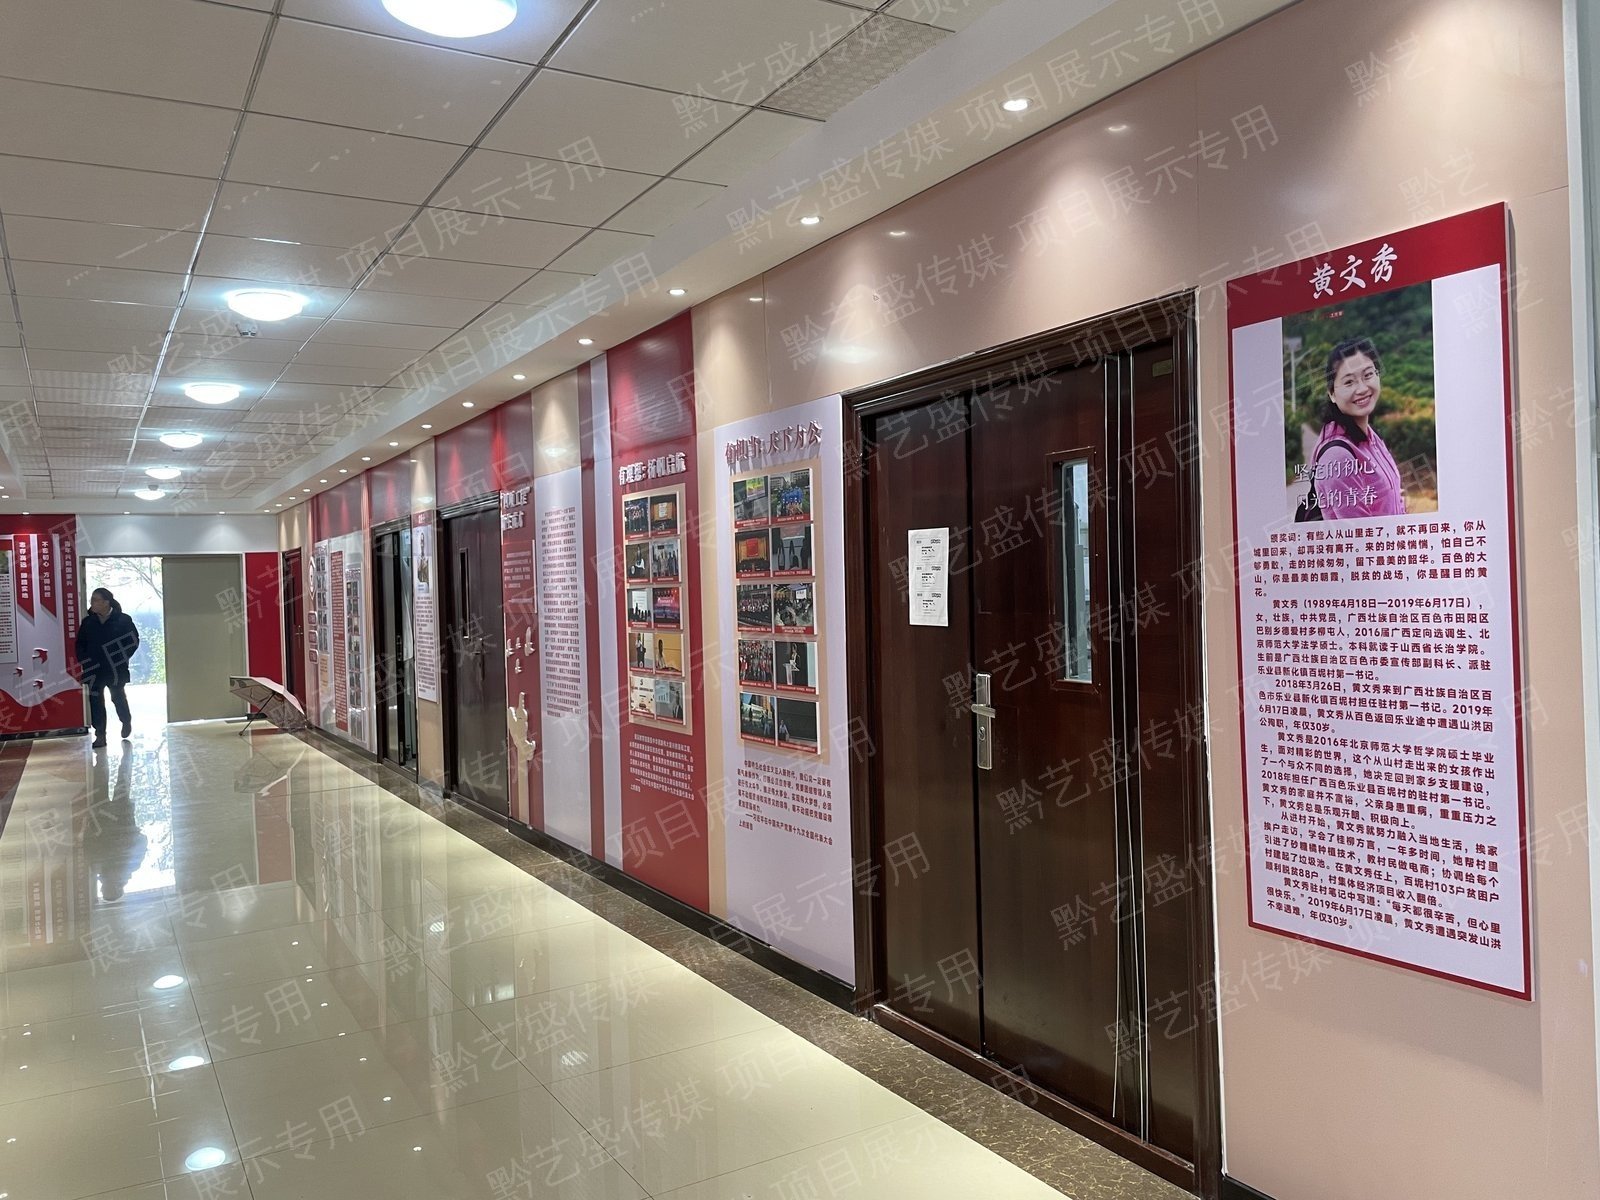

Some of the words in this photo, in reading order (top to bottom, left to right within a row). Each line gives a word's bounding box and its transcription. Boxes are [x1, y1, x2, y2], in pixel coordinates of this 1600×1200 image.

[1309, 243, 1398, 299] 黄文秀
[1294, 458, 1376, 482] 坚定的初心
[1297, 486, 1378, 511] 闪光的青春
[1255, 588, 1266, 597] 花。
[1256, 613, 1489, 624] 女，壮族，中共党员，广西壮族自治区百色市田阳区
[1258, 666, 1379, 681] 乐业县新化镇百坭村第一书记。
[1276, 679, 1492, 701] 2018年3月26日，黄文秀来到广西壮族自治区百
[1260, 717, 1336, 733] 公殉职，年仅30岁。
[1278, 732, 1494, 764] 黄文秀是2016年北京师范大学哲学院硕士毕业
